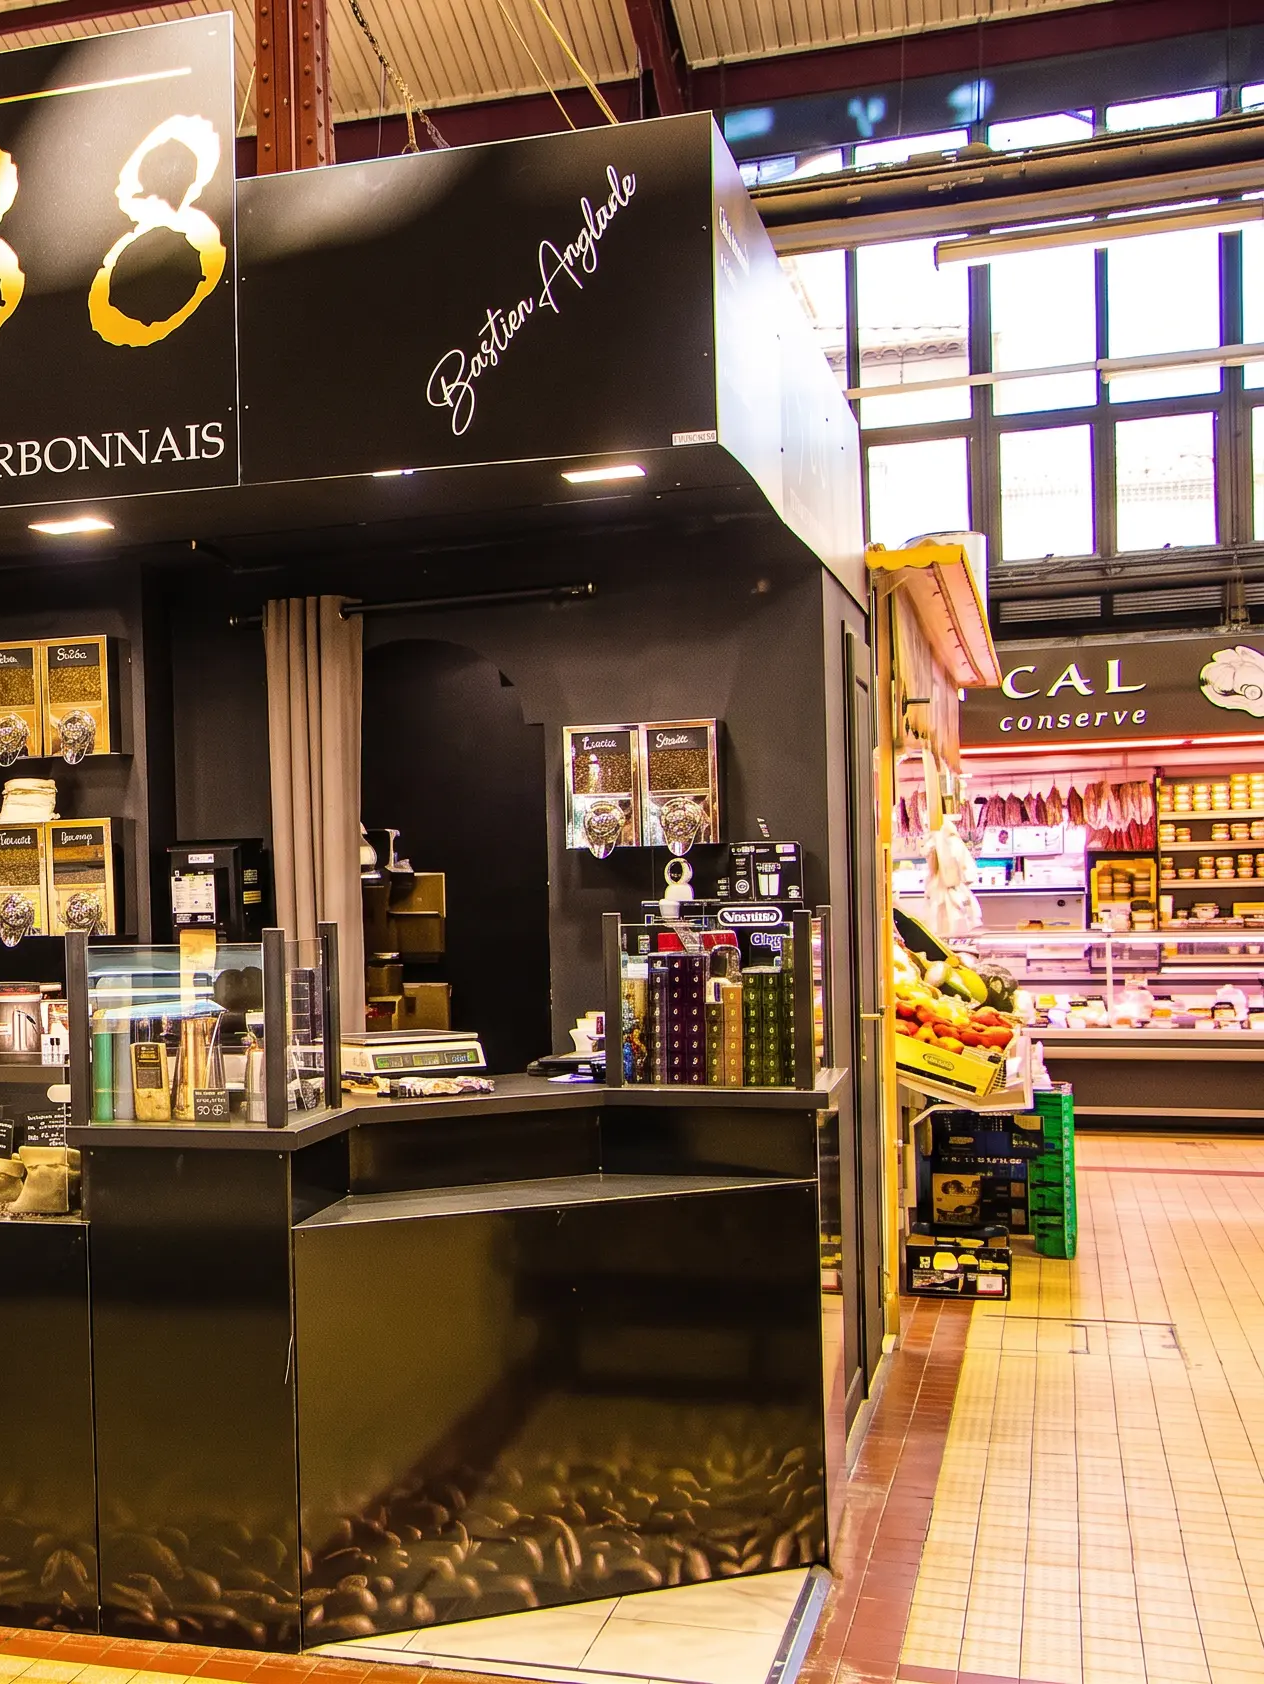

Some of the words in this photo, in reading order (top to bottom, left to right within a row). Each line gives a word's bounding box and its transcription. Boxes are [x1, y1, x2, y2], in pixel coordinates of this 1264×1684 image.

[426, 297, 535, 436] Bastien
[538, 165, 637, 314] Anglade
[1000, 659, 1148, 700] CAL
[999, 707, 1148, 732] conserve
